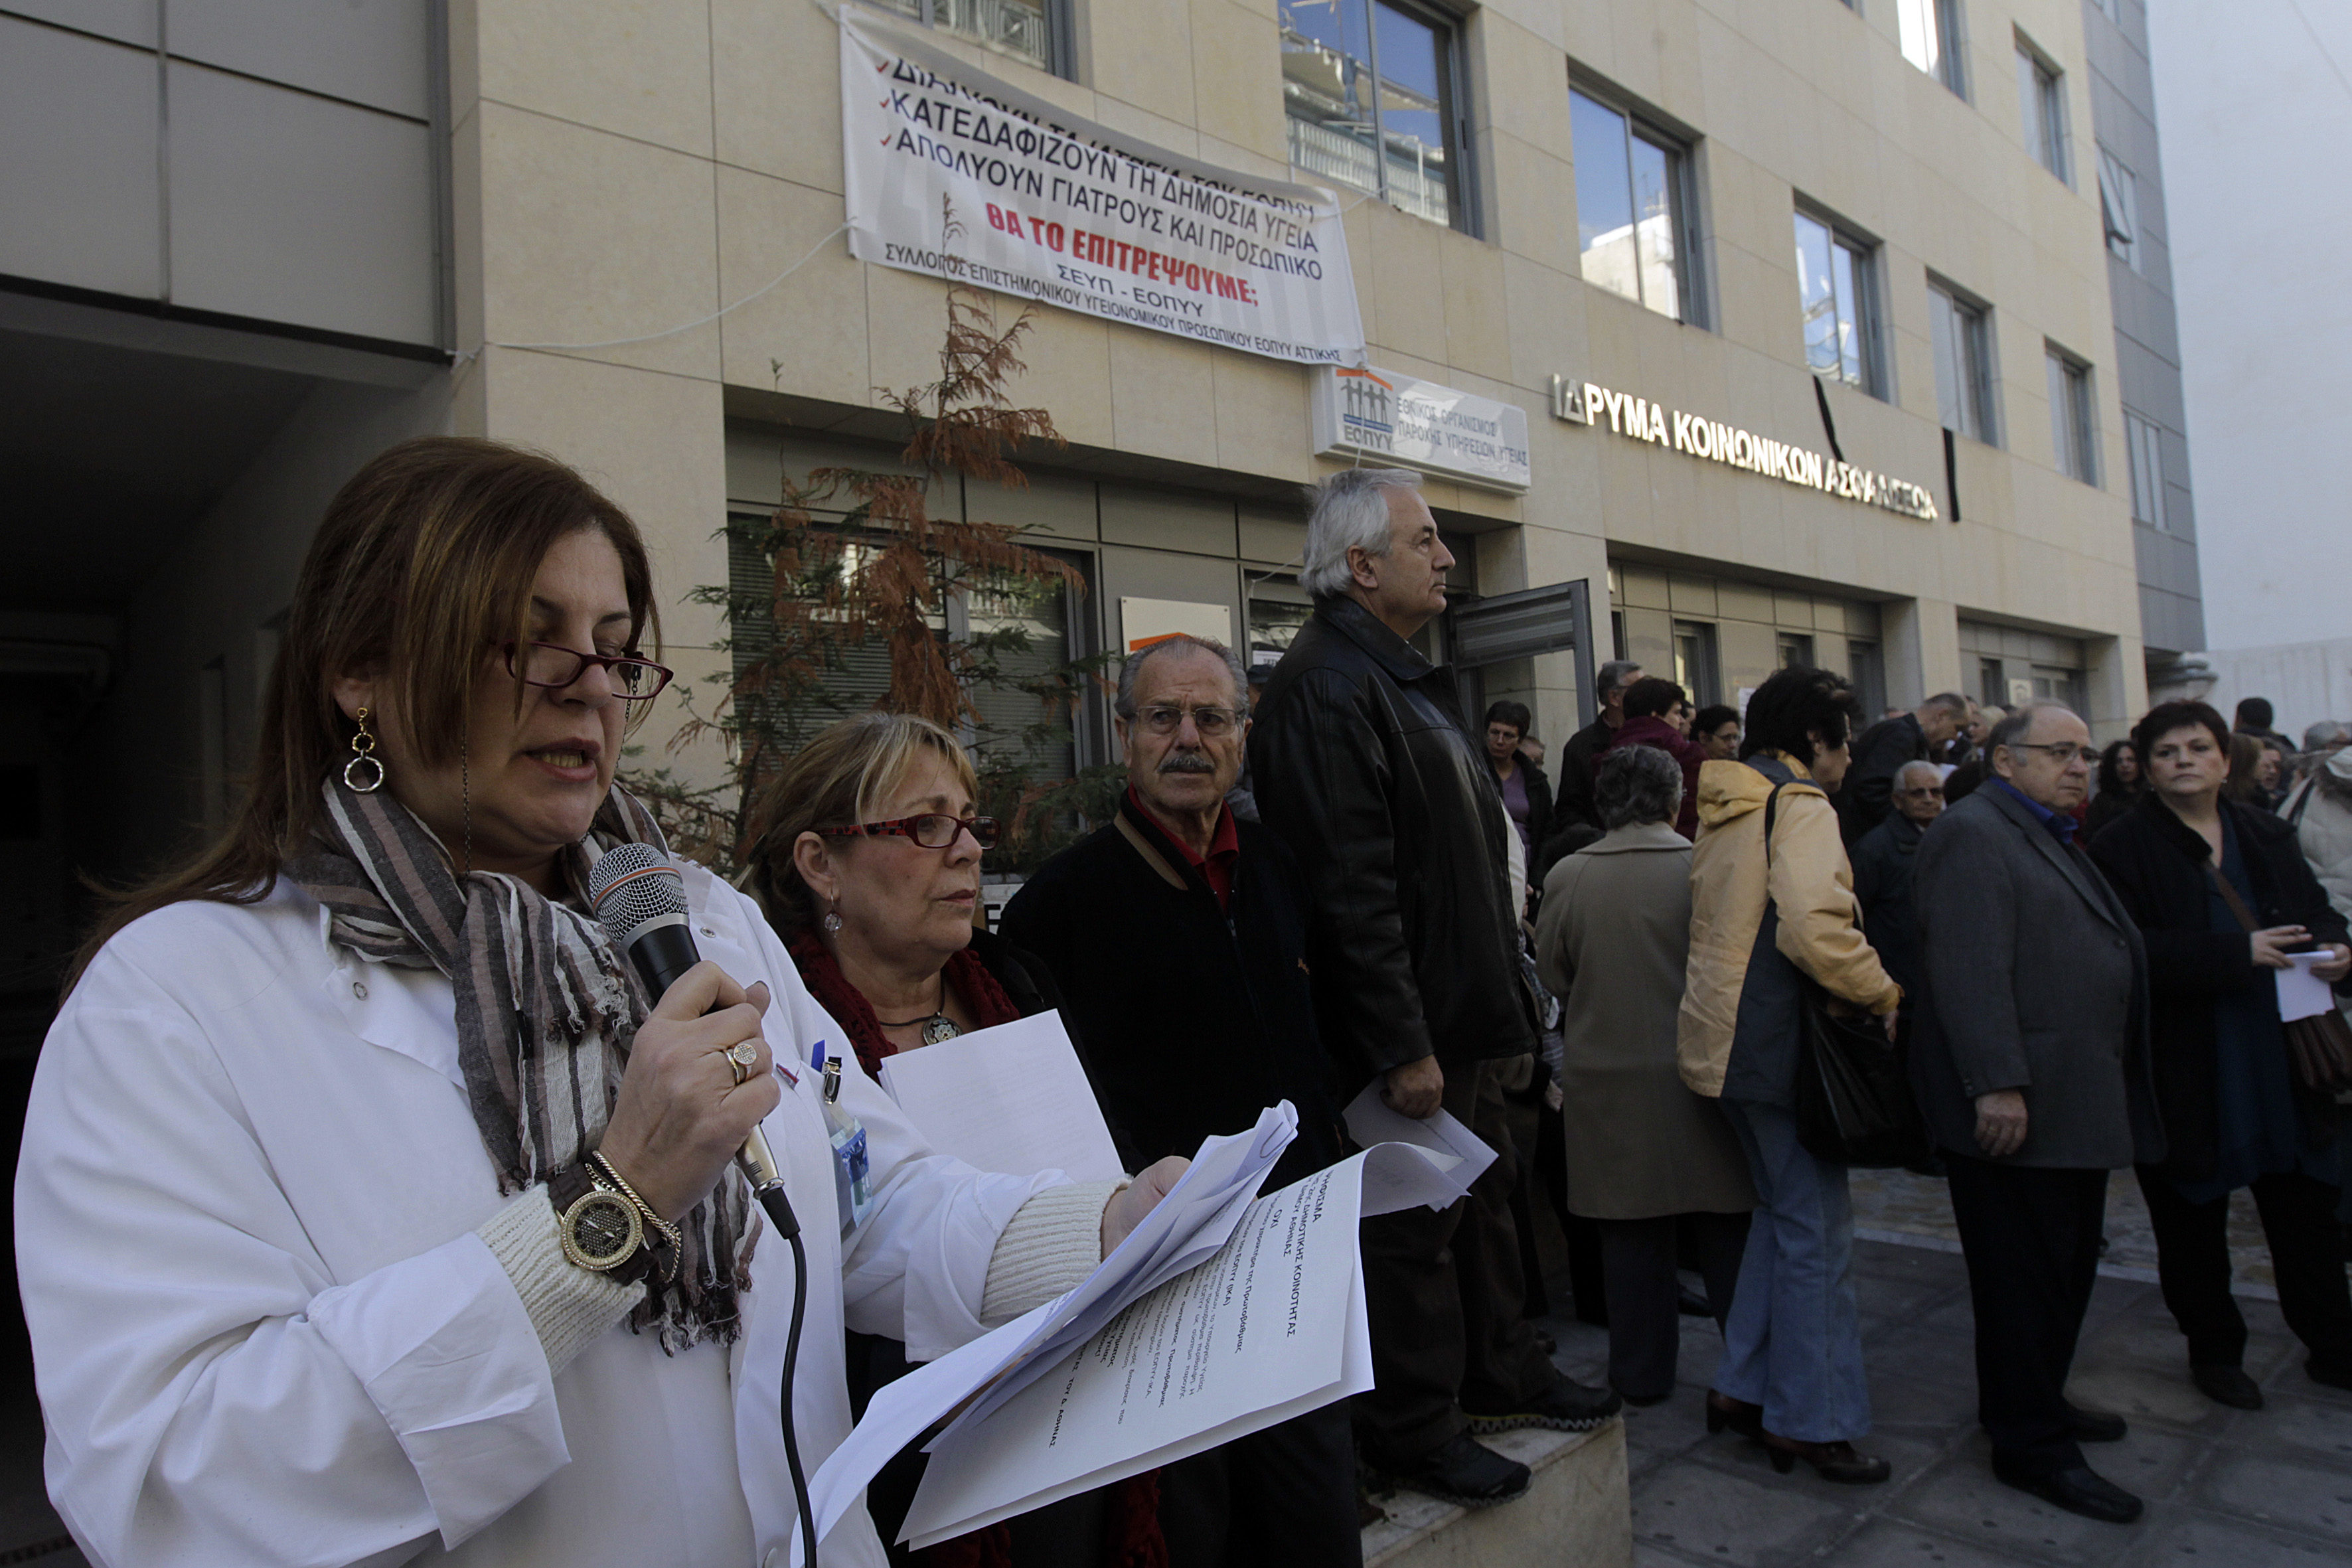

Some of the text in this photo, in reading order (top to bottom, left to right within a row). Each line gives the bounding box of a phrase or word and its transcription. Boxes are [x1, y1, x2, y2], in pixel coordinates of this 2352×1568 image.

[891, 88, 1117, 183] ΚΑΤΕΔΑΦΙΖΟΥΝ
[1126, 163, 1156, 196] ΤΗ
[1162, 177, 1258, 233] ΔΗΜΟΣΙΑ
[1265, 212, 1319, 253] ΥΓΕΙΑ
[896, 127, 1043, 198] ΑΠΟΛΥΟΥΝ
[1052, 177, 1163, 234] ΓΙΑΤΡΟΥΣ
[1170, 214, 1204, 247] ΚΑΙ
[1210, 228, 1322, 280] ΠΡΟΣΩΠΙΚΟ
[986, 202, 1258, 307] ΘΑ ΤΟ ΕΠΙΤΡΕΨΟΥΜΕ;
[970, 264, 1081, 306] ΕΠΙΣΤΗΜΟΝΙΚΟΥ
[1083, 293, 1175, 332] ΥΓΕΙΟΝΟΜΙΚΟΥ
[1178, 319, 1252, 348] ΠΡΟΣΩΠΙΚΟΥ
[1255, 337, 1292, 356] ΕΟΠΥΥ
[1295, 345, 1342, 362] ΑΤΤΙΚΗΣ
[1057, 263, 1114, 295] ΣΕΥΠ
[1133, 286, 1203, 317] ΕΟΠΥΥ
[1344, 425, 1393, 451] ΕΟΠΥΥ
[1397, 396, 1496, 437] ΕΘΝΙΚΟΣ ΟΡΓΑΝΙΣΜΟΣ
[1397, 421, 1442, 446] ΠΑΡΟΧΗΣ
[1553, 373, 1670, 447] ΙΔΡΥΜΑ
[1673, 410, 1823, 489] ΚΟΙΝΩΝΙΚΩΝ
[1283, 1217, 1297, 1257] ΑΘΗΝΑΣ
[1295, 1204, 1310, 1263] ΔΗΜΟΤΙΚΗΣ
